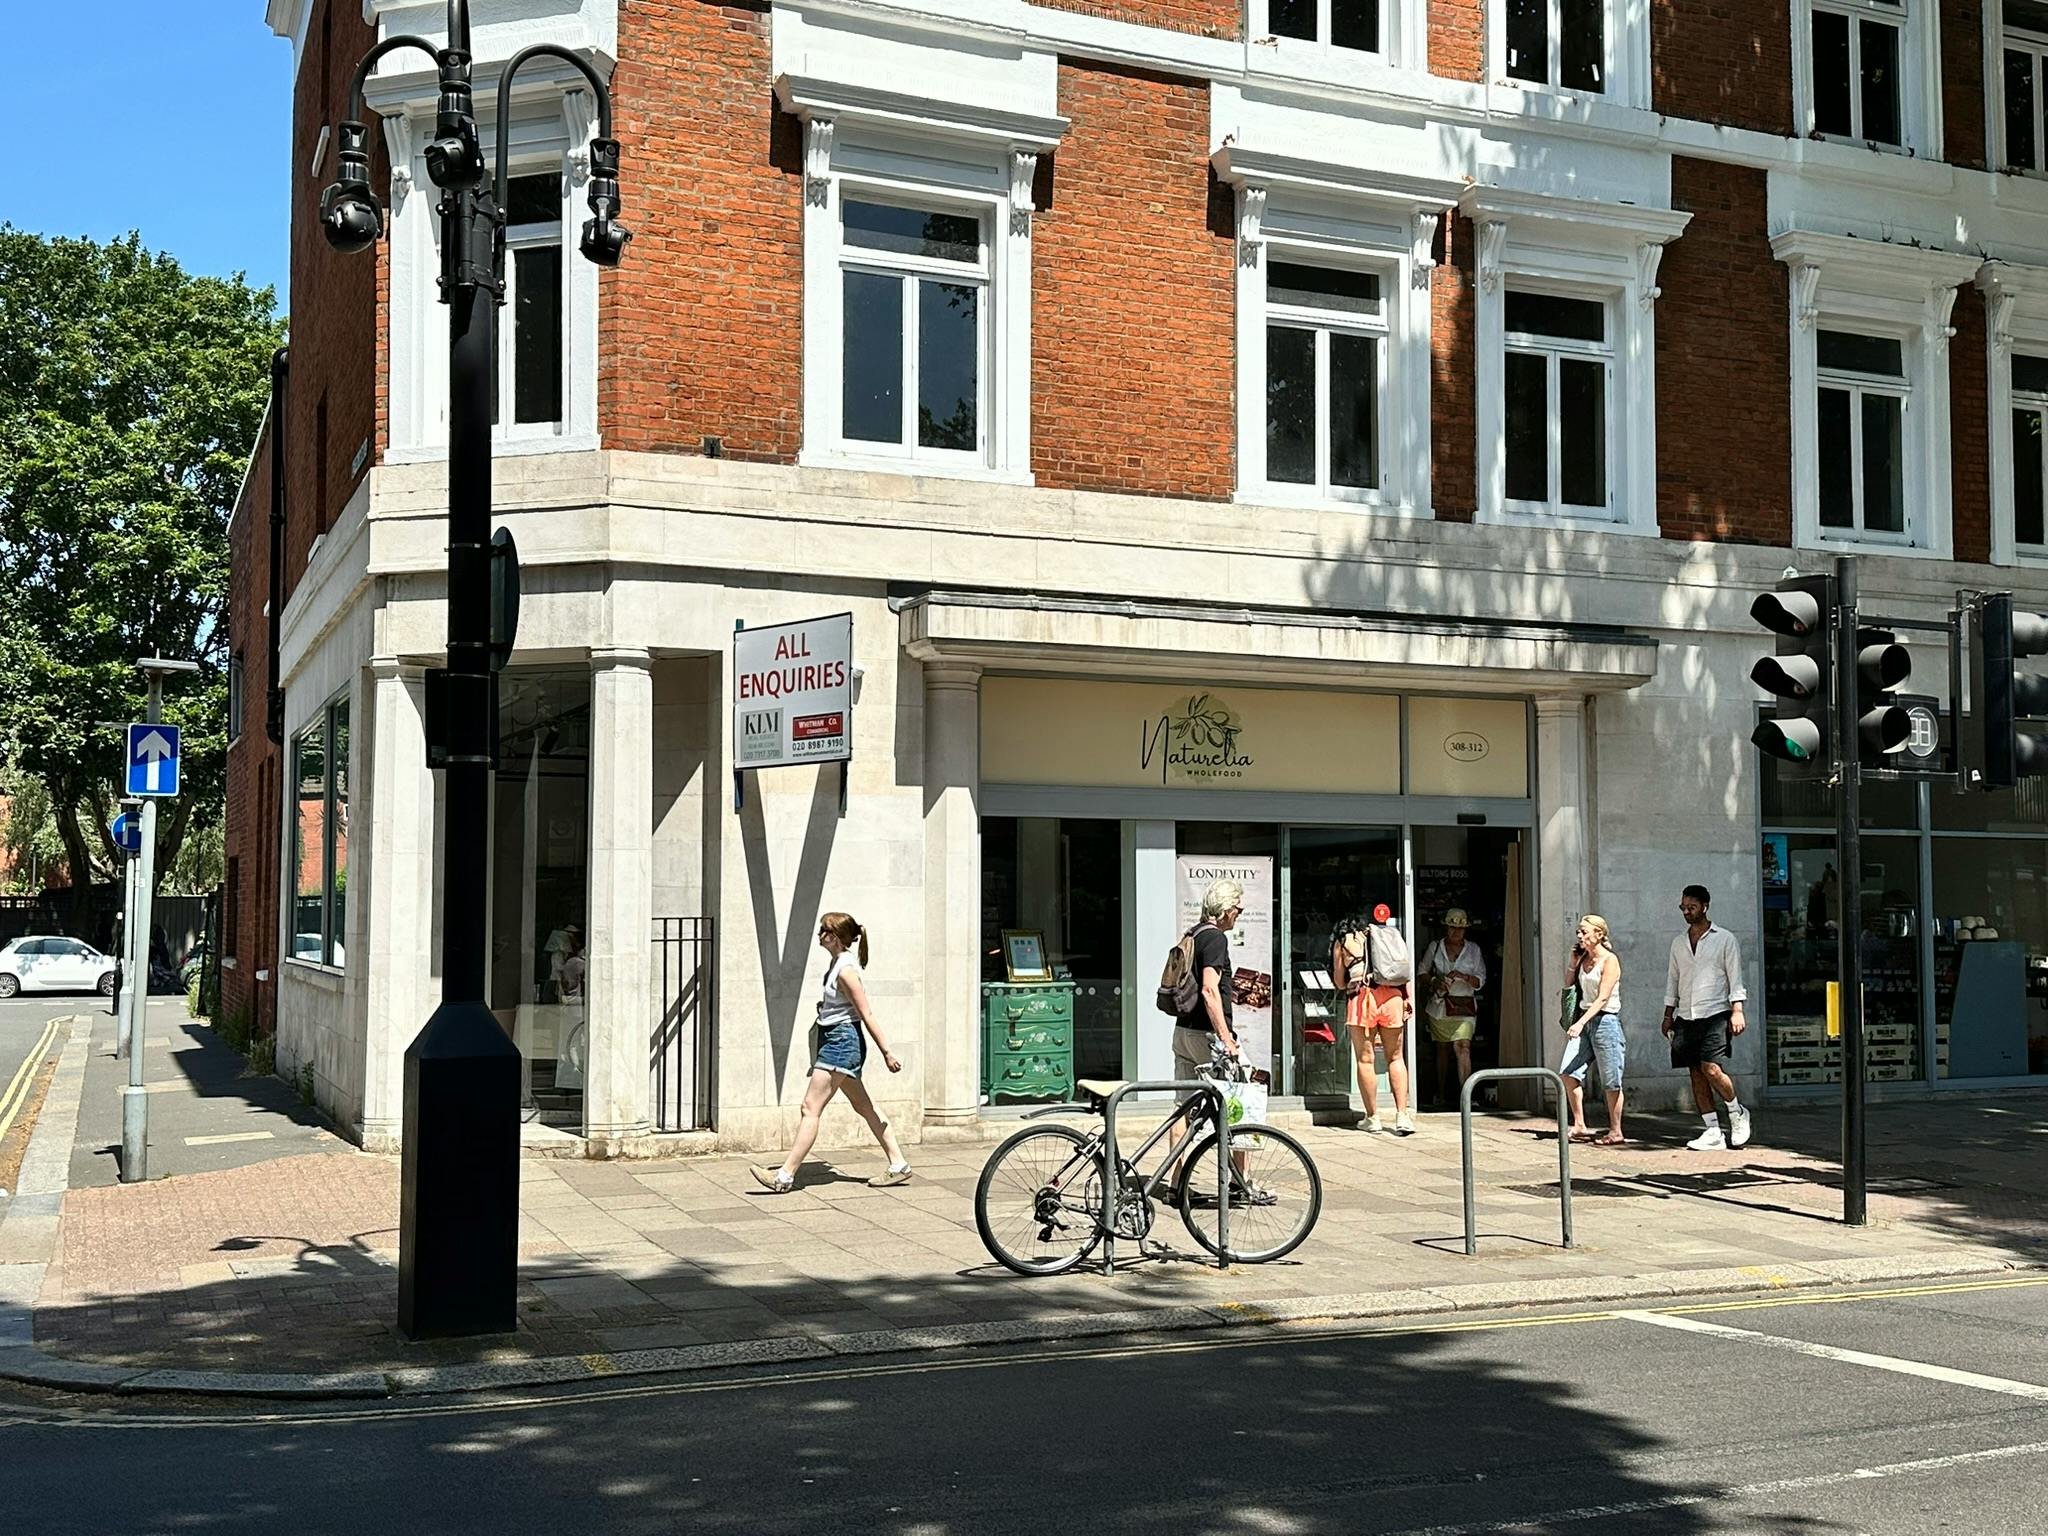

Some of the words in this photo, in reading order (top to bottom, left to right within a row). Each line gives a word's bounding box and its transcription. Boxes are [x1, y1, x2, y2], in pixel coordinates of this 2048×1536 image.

[775, 632, 810, 661] ALL
[740, 661, 845, 699] ENQUIRIES
[745, 711, 779, 735] KLM
[792, 742, 806, 751] 020
[808, 740, 825, 750] 8987
[1142, 715, 1254, 785] Naturelia
[1450, 742, 1483, 752] 308-312
[1186, 769, 1243, 778] WHOLEFOOD
[1189, 867, 1257, 880] LONDEVITY
[1450, 868, 1469, 879] BOSS
